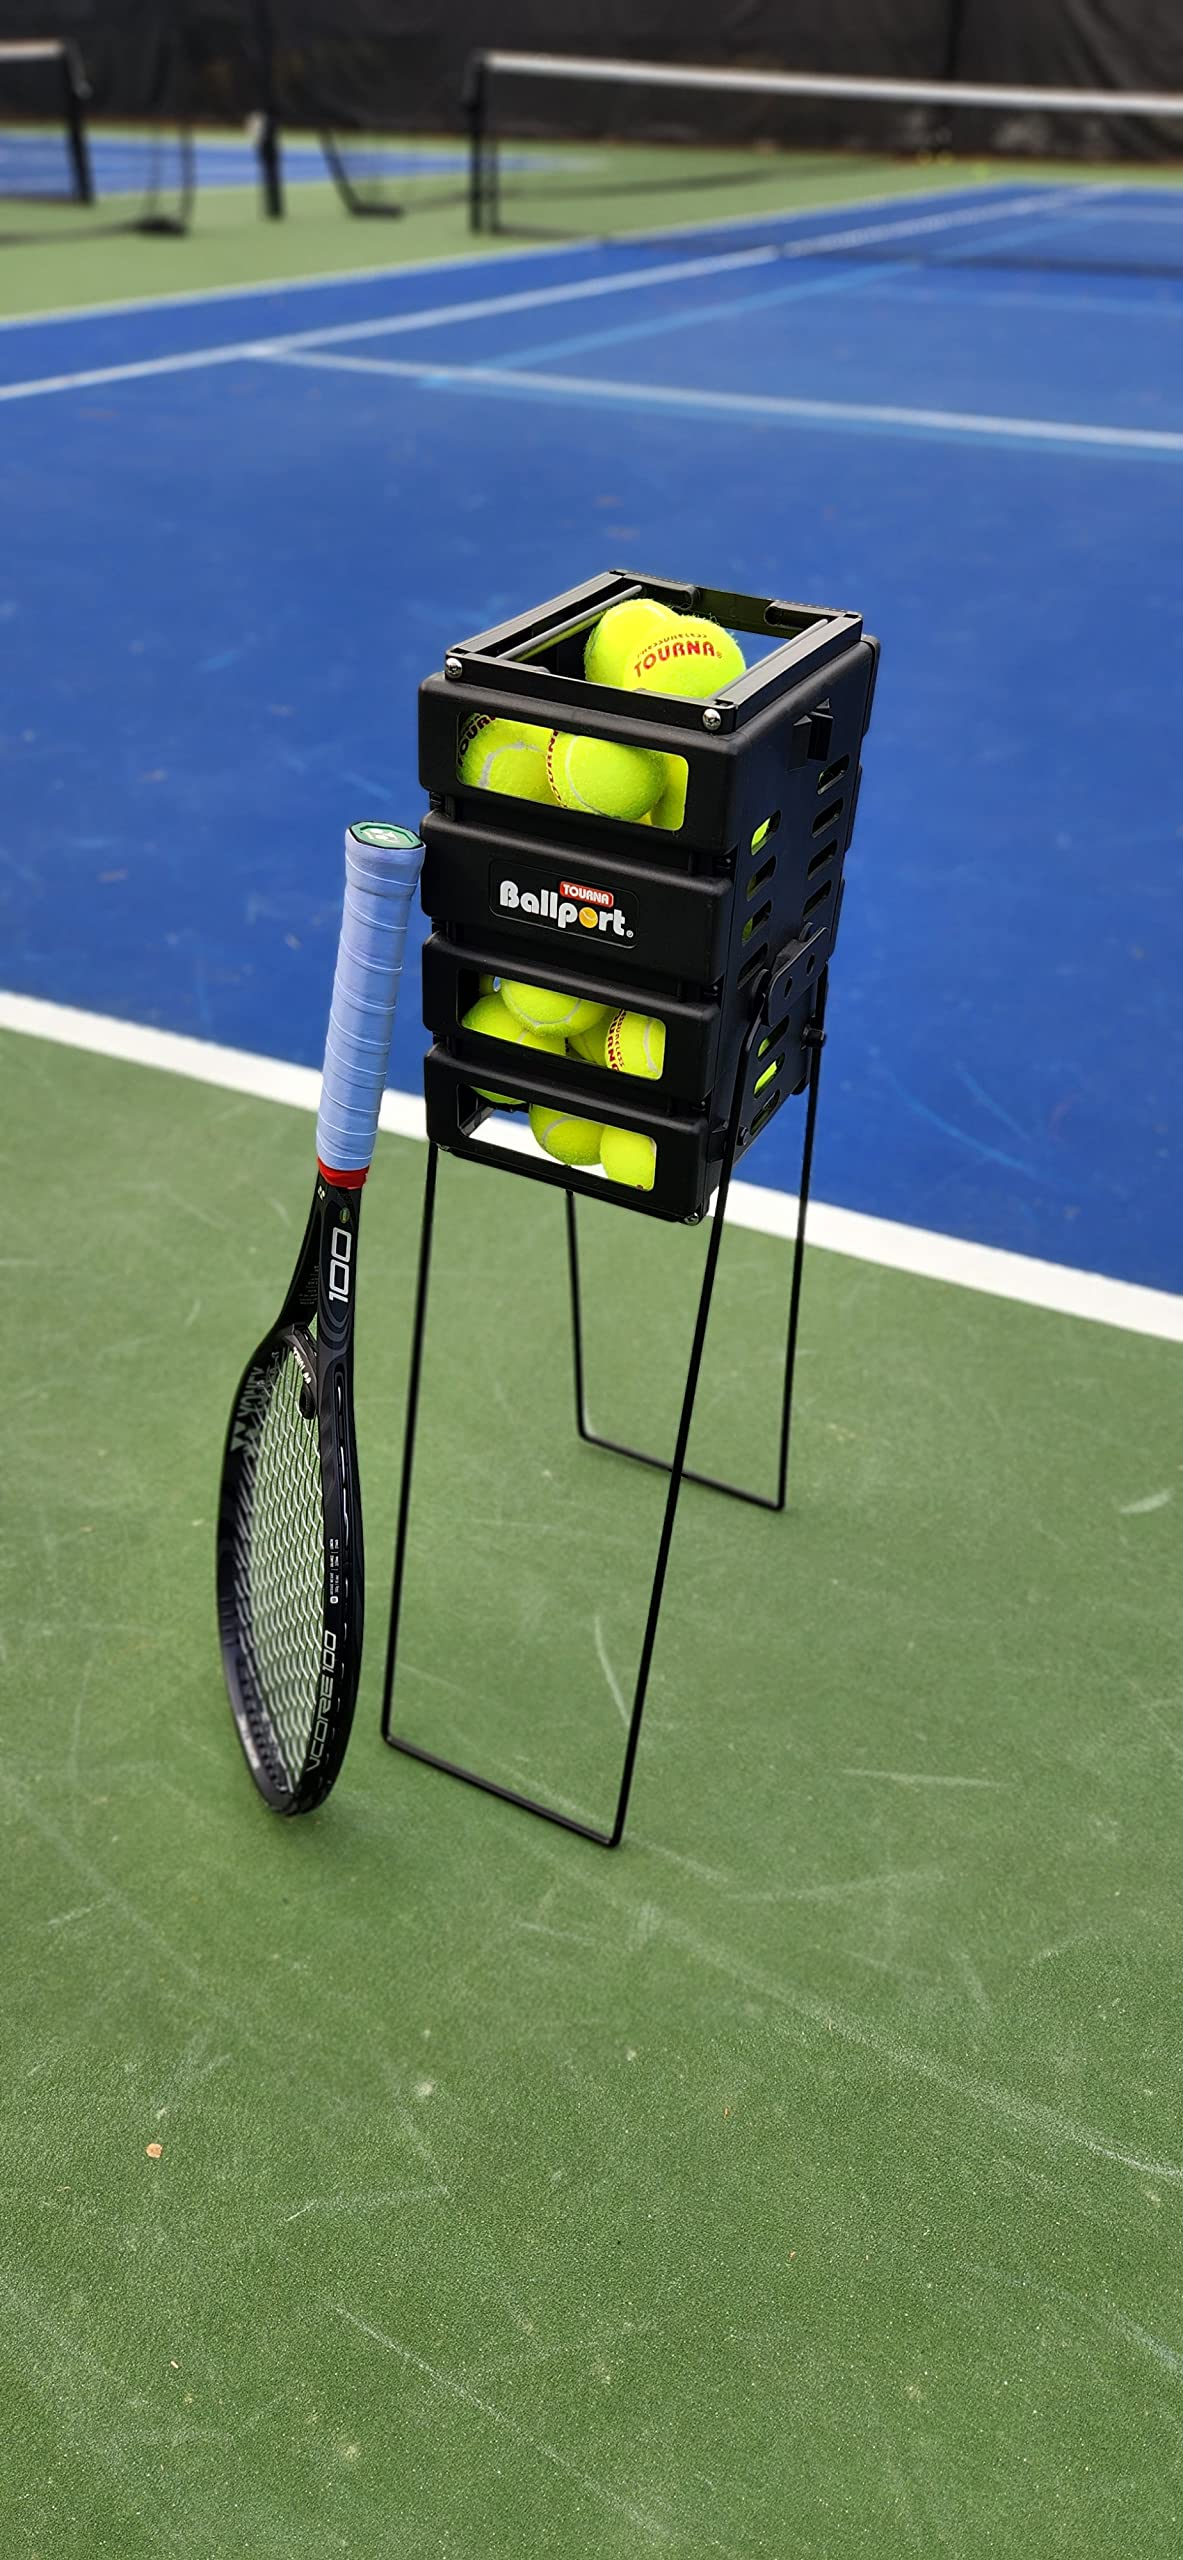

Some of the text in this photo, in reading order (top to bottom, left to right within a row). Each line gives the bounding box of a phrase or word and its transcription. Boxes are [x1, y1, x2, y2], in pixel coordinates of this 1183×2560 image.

[634, 640, 715, 678] TOURNA
[562, 884, 609, 905] TOURNA
[328, 1227, 352, 1303] 100
[306, 1629, 337, 1772] VCORE 100
